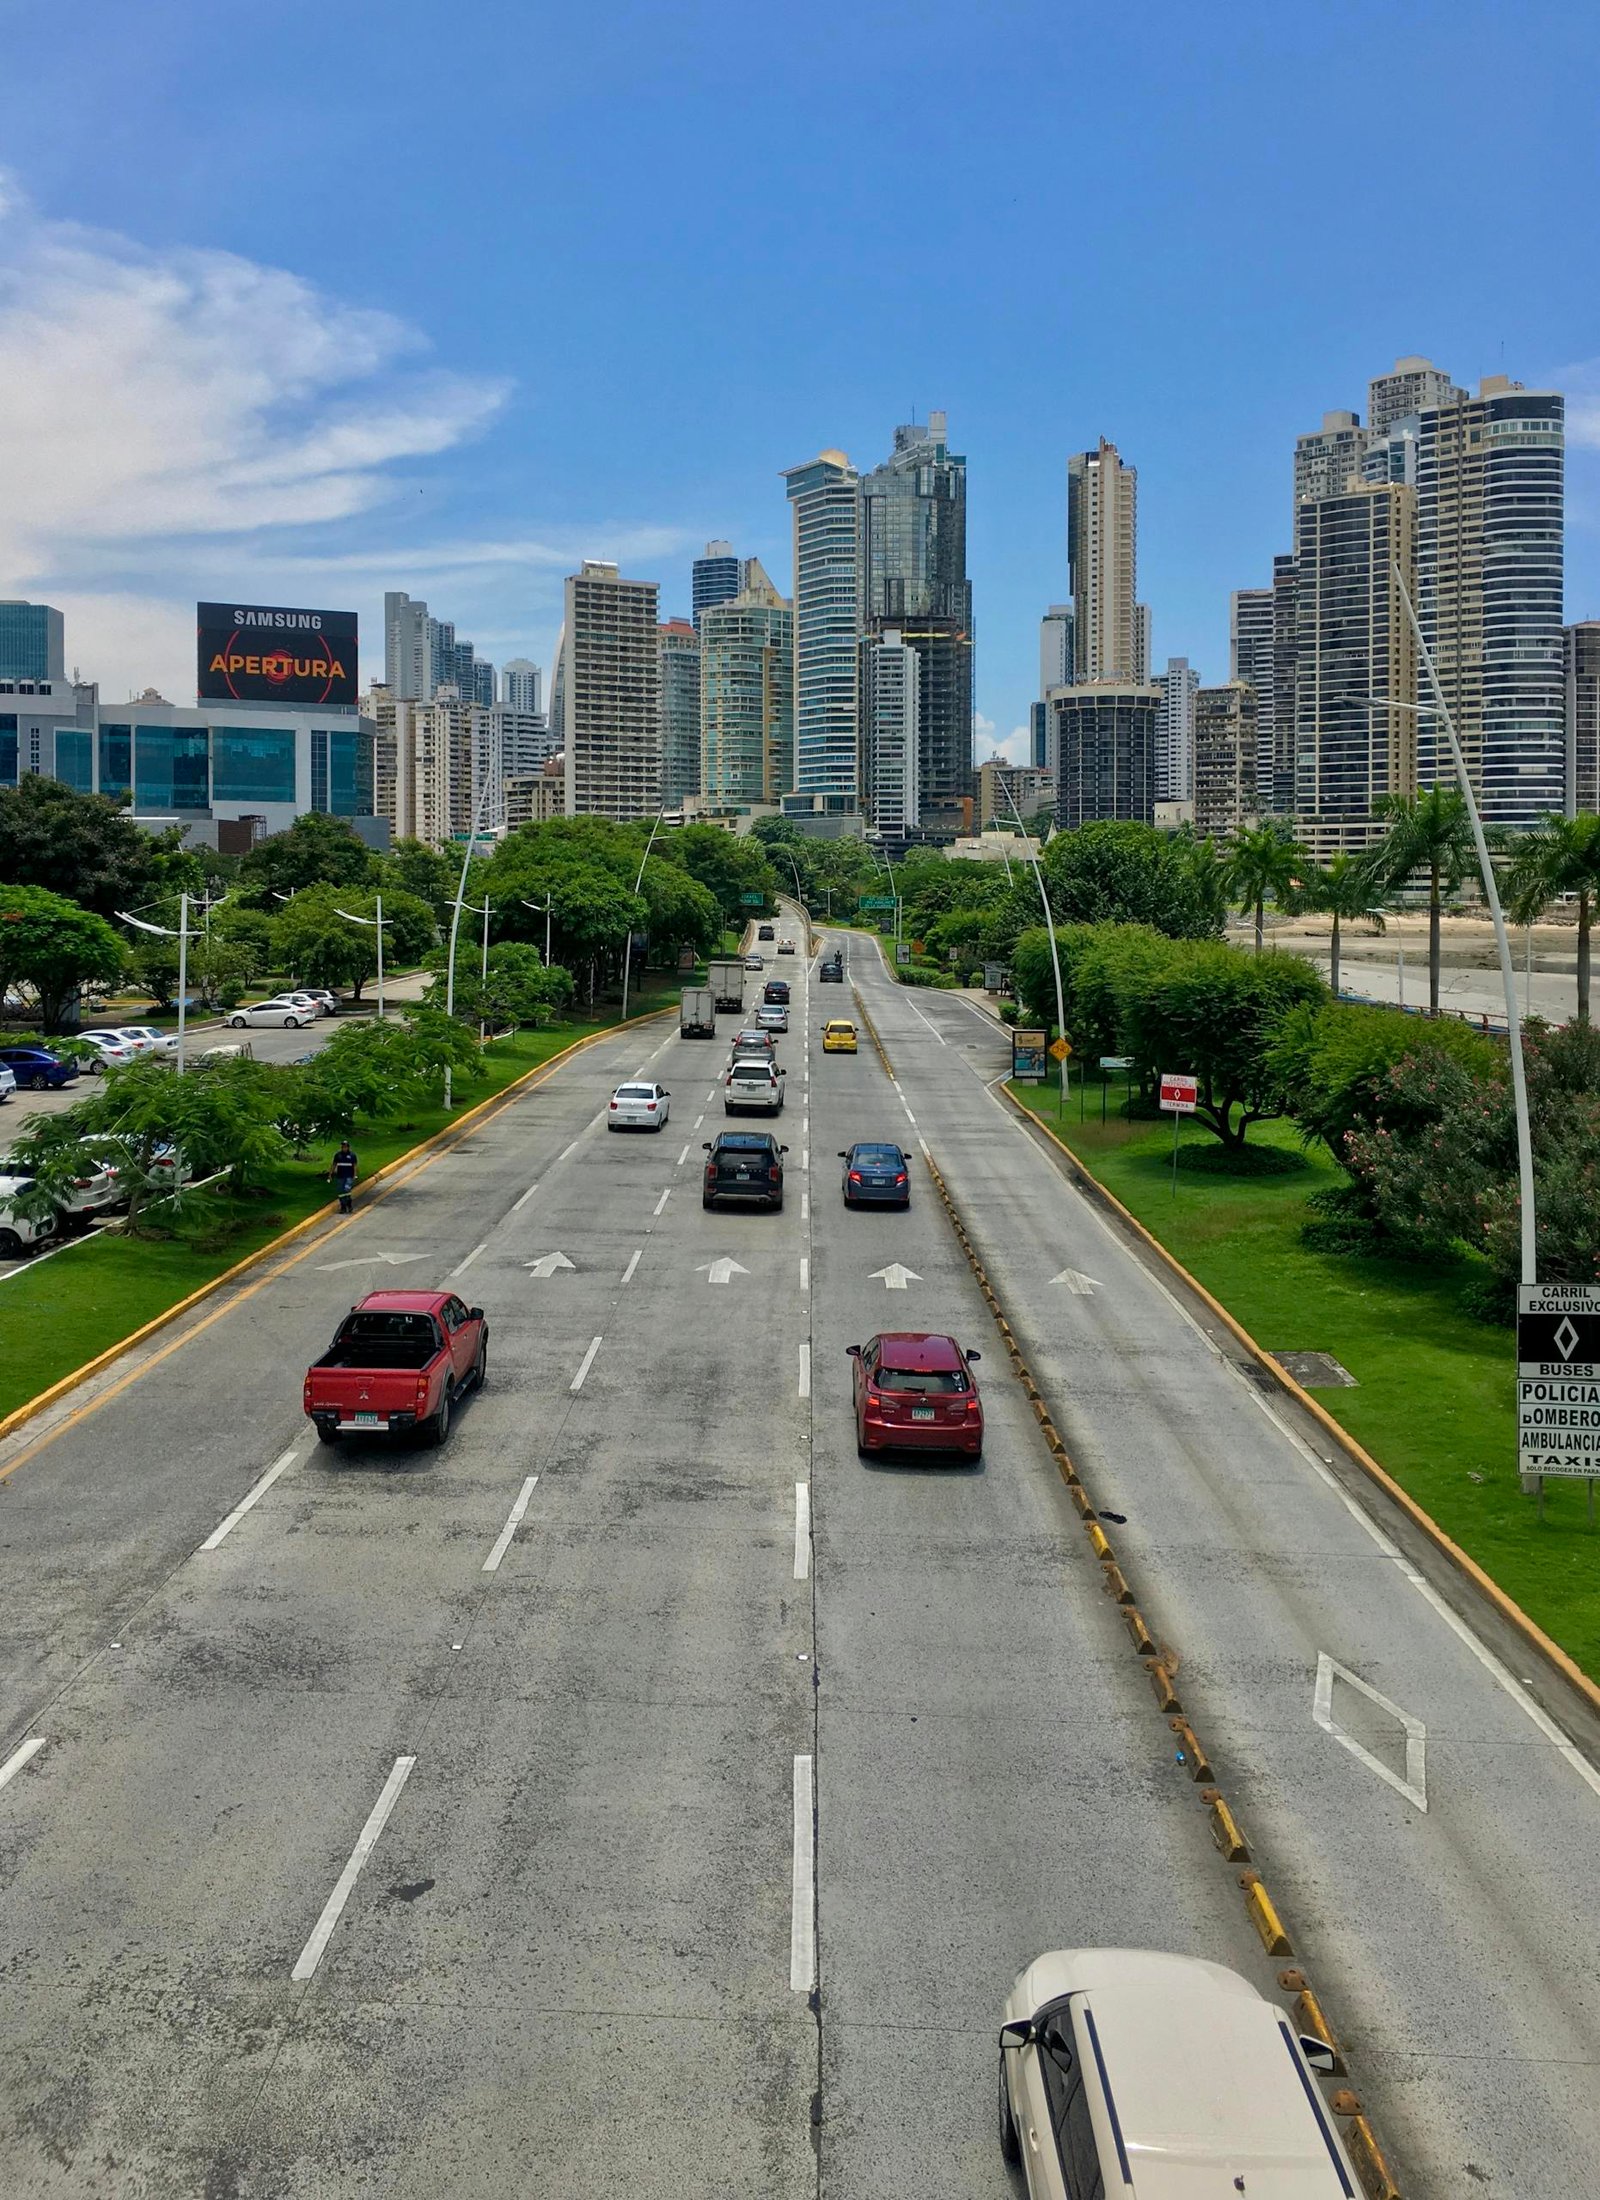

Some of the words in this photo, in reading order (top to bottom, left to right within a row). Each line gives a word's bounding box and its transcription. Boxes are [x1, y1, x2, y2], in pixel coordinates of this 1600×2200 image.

[233, 610, 322, 630] SAMSUNG
[209, 654, 346, 679] APERTURA
[1542, 1287, 1591, 1298] CARRIL
[1529, 1300, 1600, 1312] EXCLUSIVO
[1540, 1364, 1594, 1377] BUSES
[1522, 1384, 1600, 1403] POLICIA
[1521, 1432, 1600, 1451] AMBULANCIA
